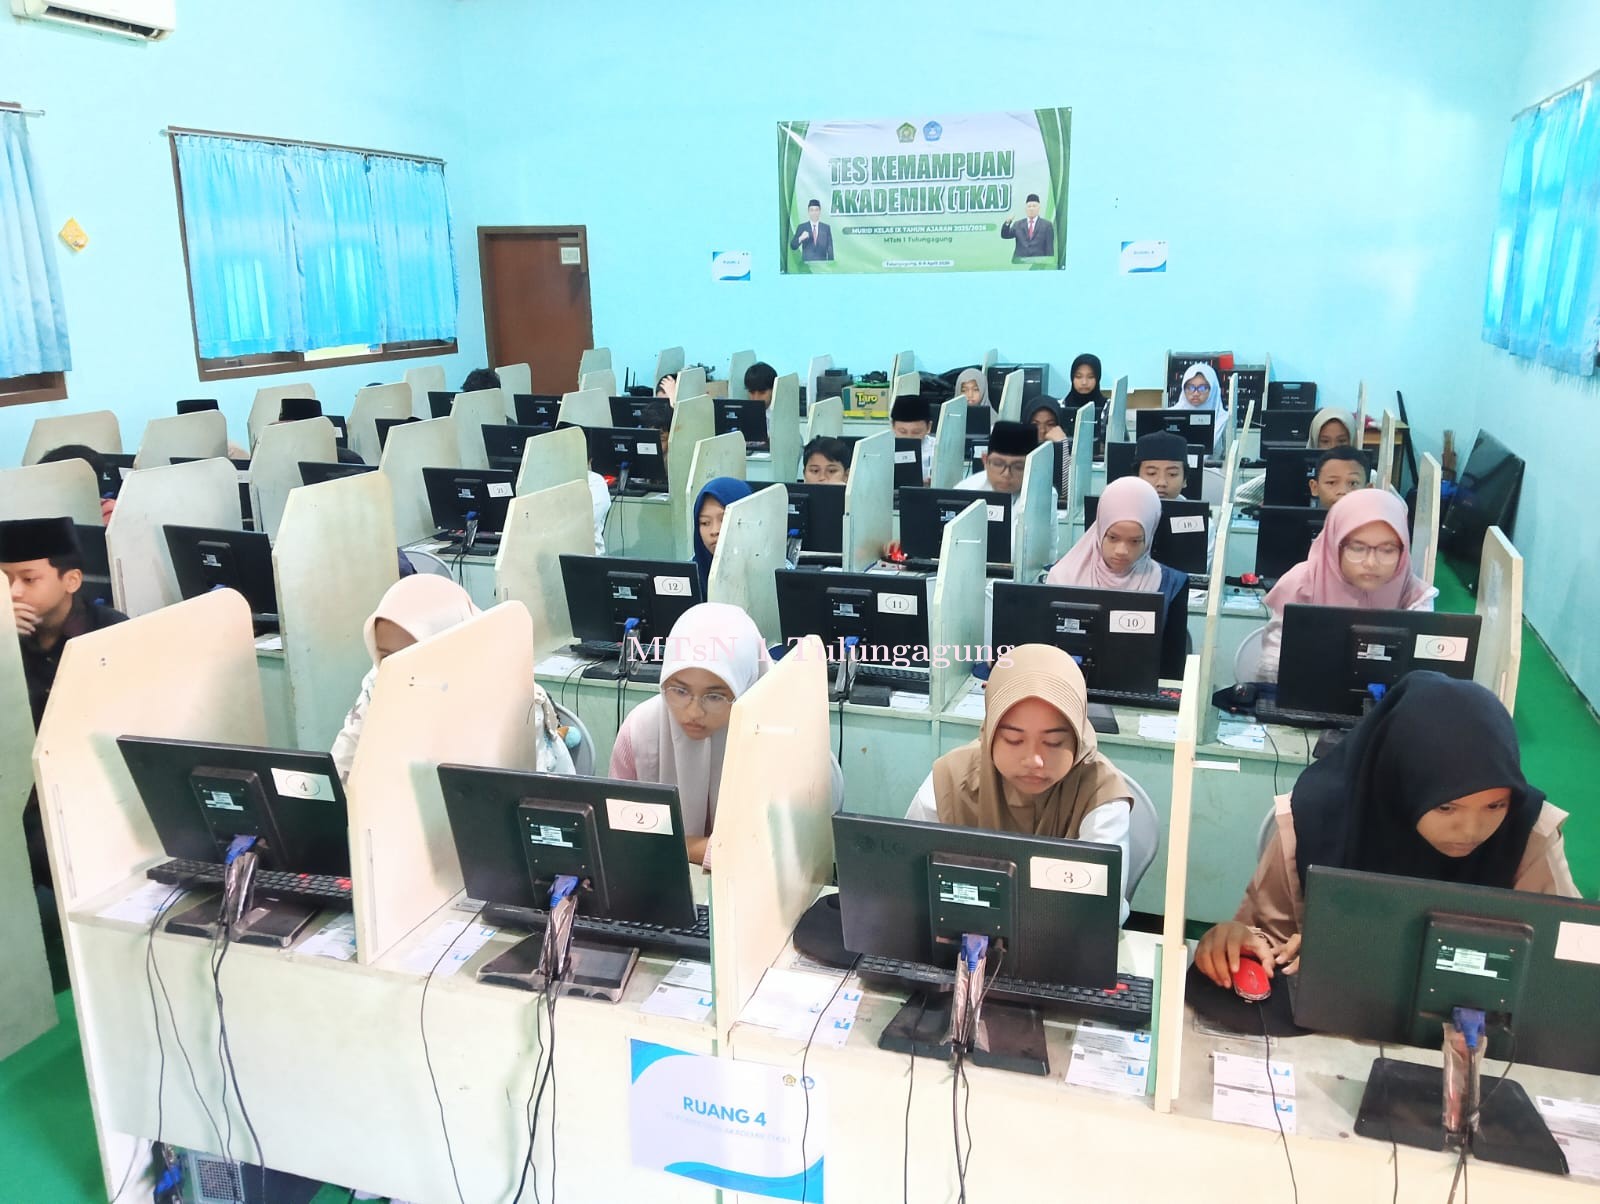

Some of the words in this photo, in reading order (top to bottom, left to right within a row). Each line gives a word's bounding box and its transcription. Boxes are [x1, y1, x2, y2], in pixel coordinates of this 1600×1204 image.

[829, 155, 867, 184] TES
[871, 150, 1013, 181] KEMAMPUAN
[829, 186, 944, 215] AKADEMIK
[947, 184, 1010, 212] (TKA)
[926, 225, 953, 233] AJARAN
[908, 236, 953, 244] Tulungagung
[855, 391, 879, 404] Taro
[668, 582, 678, 591] 12
[892, 599, 902, 609] 11
[1127, 617, 1139, 628] 10
[1437, 643, 1445, 654] 9
[634, 811, 645, 825] 2
[1063, 871, 1074, 885] 3
[683, 1096, 750, 1124] RUANG
[754, 1112, 767, 1127] 4
